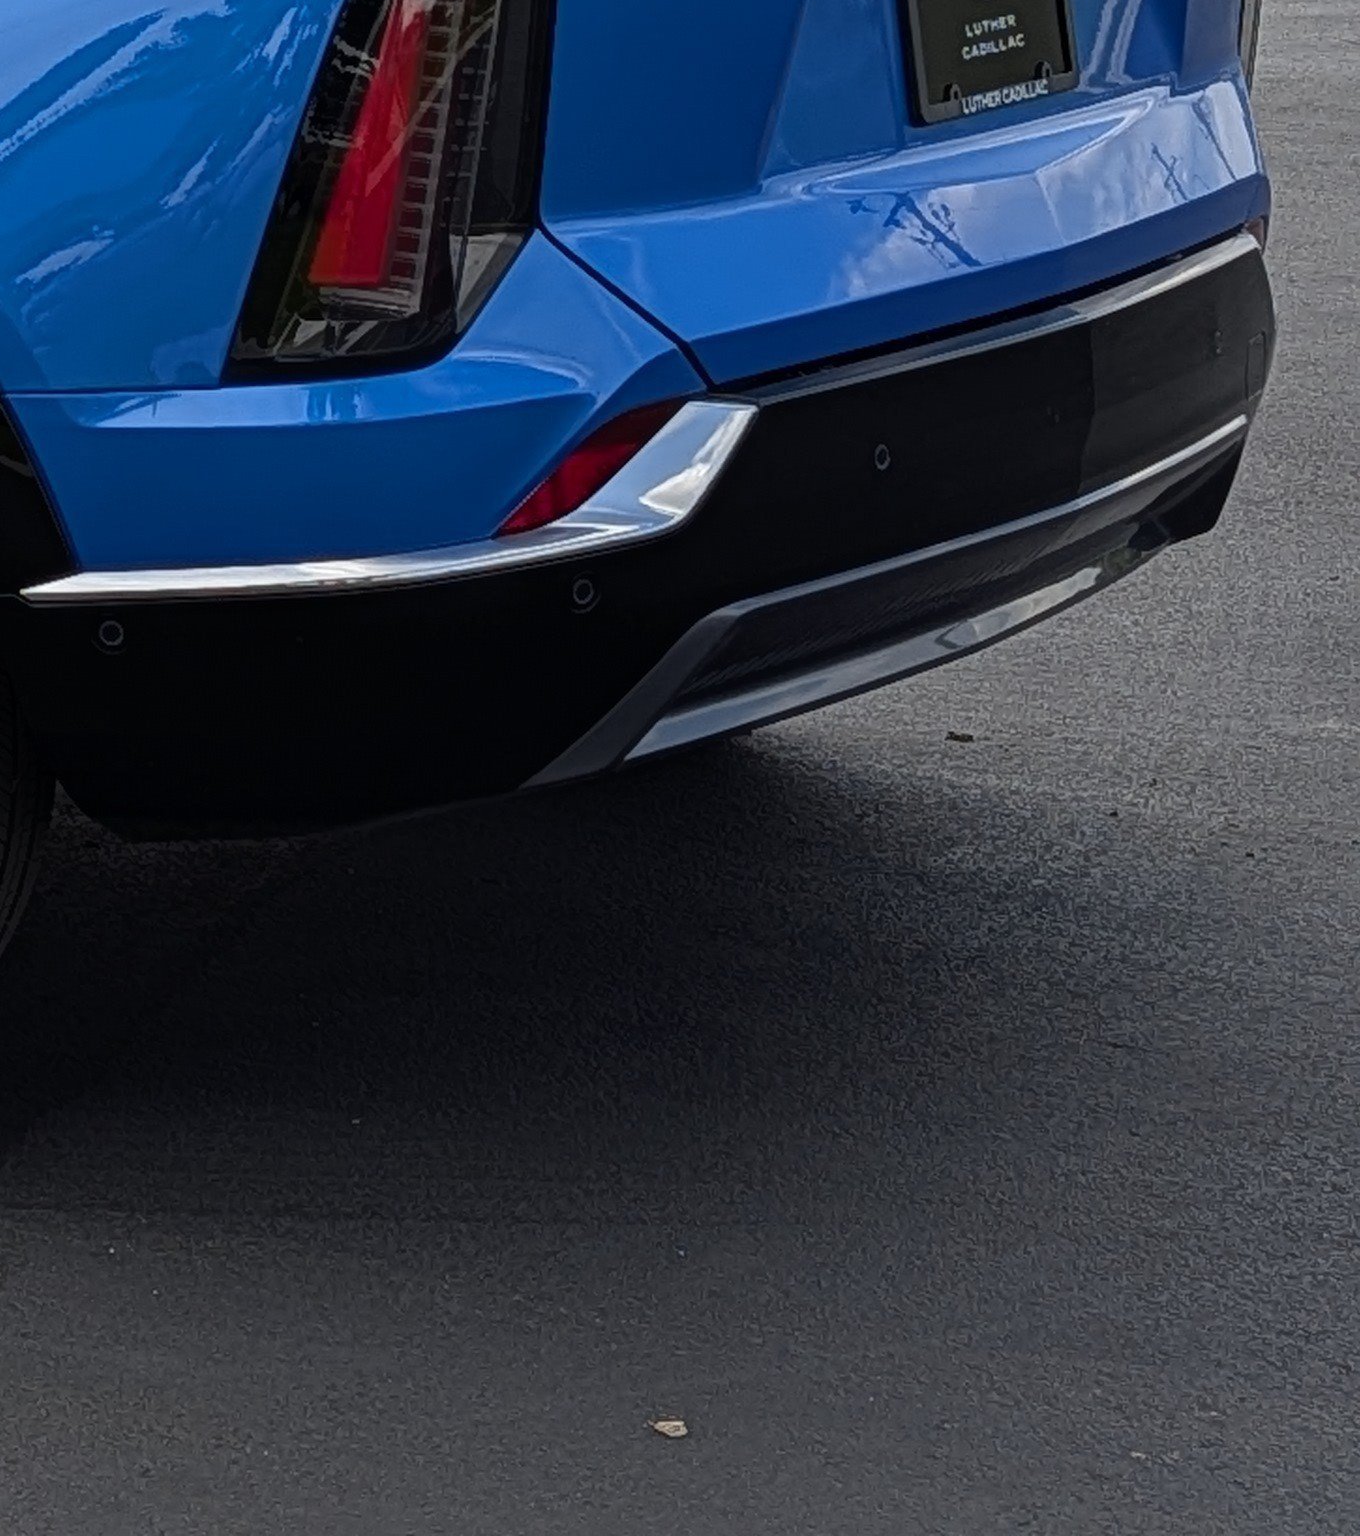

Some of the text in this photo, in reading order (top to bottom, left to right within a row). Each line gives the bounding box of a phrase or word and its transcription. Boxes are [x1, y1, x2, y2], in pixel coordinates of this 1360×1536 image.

[965, 14, 1017, 38] LUTHER
[962, 33, 1026, 60] CADILLAC
[961, 79, 1049, 114] LUTHER CADILLAC
